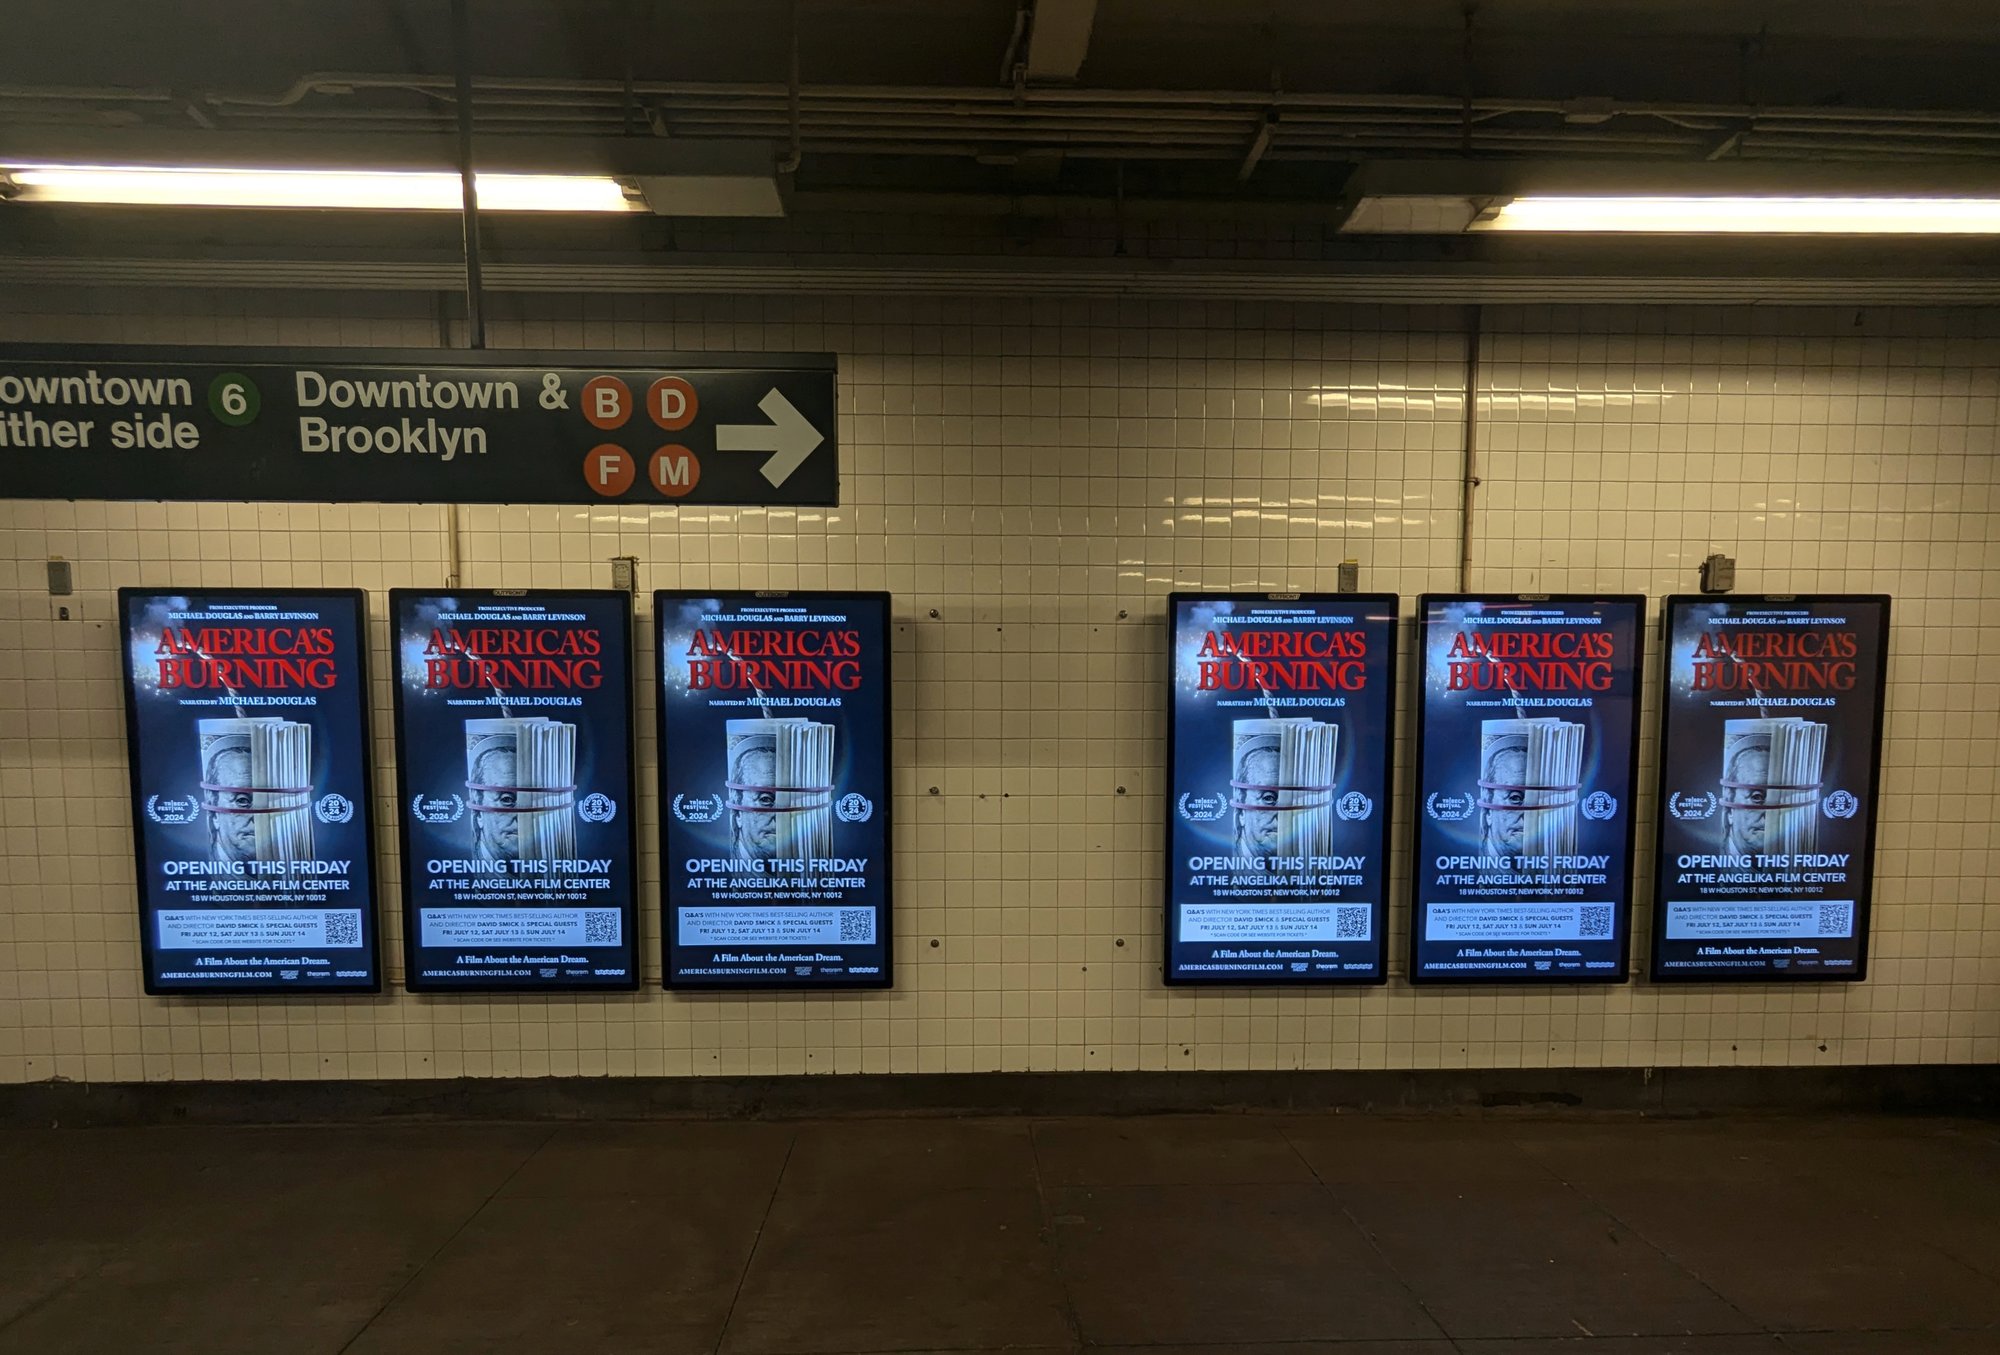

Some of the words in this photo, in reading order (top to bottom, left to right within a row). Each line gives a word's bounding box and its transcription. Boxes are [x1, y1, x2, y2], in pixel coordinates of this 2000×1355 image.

[0, 370, 192, 406] owntown
[296, 371, 519, 409] Downtown
[539, 373, 569, 410] &
[223, 386, 248, 419] 6
[596, 388, 620, 418] B
[661, 389, 686, 418] D
[0, 411, 95, 448] ither
[111, 412, 200, 449] side
[300, 416, 487, 460] Brooklyn
[600, 456, 621, 485] F
[660, 457, 689, 485] M
[152, 626, 334, 655] AMERICA'S
[422, 627, 601, 655] AMERICA'S
[685, 629, 860, 656] AMERICA'S
[1196, 630, 1366, 658] AMERICA'S
[1446, 631, 1614, 658] AMERICA'S
[1691, 630, 1858, 659] AMERICA'S
[155, 657, 337, 689] BURNING
[424, 658, 603, 689] BURNING
[686, 659, 862, 690] BURNING
[1197, 660, 1367, 691] BURNING
[1446, 660, 1614, 691] BURNING
[1690, 660, 1857, 691] BURNING
[218, 696, 266, 705] MICHAEL
[267, 696, 316, 705] DOUGLAS
[485, 697, 532, 705] MICHAEL
[533, 697, 581, 705] DOUGLAS
[746, 697, 792, 705] MICHAEL
[794, 697, 841, 706] DOUGLAS
[1299, 697, 1345, 706] DOUGLAS
[1502, 698, 1546, 706] MICHAEL
[1547, 698, 1592, 706] DOUGLAS
[1790, 697, 1835, 706] DOUGLAS
[163, 860, 244, 875] OPENING
[247, 860, 286, 874] THIS
[290, 860, 351, 874] FRIDAY
[426, 859, 507, 873] OPENING
[510, 859, 547, 873] THIS
[552, 859, 612, 873] FRIDAY
[685, 858, 764, 872] OPENING
[768, 858, 804, 872] THIS
[809, 858, 867, 872] FRIDAY
[1189, 856, 1265, 870] OPENING
[1268, 856, 1304, 869] THIS
[1308, 856, 1365, 869] FRIDAY
[1435, 855, 1511, 869] OPENING
[1514, 855, 1549, 869] THIS
[1553, 855, 1609, 869] FRIDAY
[1677, 854, 1752, 868] OPENING
[1754, 854, 1789, 867] THIS
[1793, 854, 1849, 867] FRIDAY
[428, 879, 444, 889] AT
[445, 879, 469, 889] THE
[471, 878, 532, 889] ANGELIKA
[534, 879, 560, 888] FILM
[564, 878, 610, 888] CENTER
[687, 878, 702, 888] AT
[704, 878, 727, 888] THE
[729, 877, 788, 888] ANGELIKA
[791, 878, 816, 887] FILM
[820, 877, 865, 887] CENTER
[1190, 876, 1204, 885] AT
[1206, 875, 1228, 885] THE
[1230, 875, 1288, 885] ANGELIKA
[1290, 875, 1315, 884] FILM
[1318, 875, 1362, 885] CENTER
[1436, 875, 1451, 884] AT
[1452, 875, 1474, 884] THE
[1476, 874, 1533, 884] ANGELIKA
[1535, 874, 1560, 884] FILM
[1562, 874, 1606, 884] CENTER
[1677, 874, 1692, 883] AT
[1693, 873, 1715, 883] THE
[1717, 873, 1773, 883] ANGELIKA
[1775, 873, 1800, 882] FILM
[1802, 872, 1846, 882] CENTER
[165, 881, 181, 890] AT
[182, 880, 207, 890] THE
[208, 880, 270, 890] ANGELIKA
[272, 880, 299, 890] FILM
[302, 880, 349, 890] CENTER
[456, 955, 463, 963] A
[465, 955, 482, 963] Film
[484, 955, 508, 963] About
[509, 955, 521, 963] the
[523, 955, 559, 963] American
[560, 955, 589, 963] Dream.
[1465, 948, 1481, 956] Film
[1483, 948, 1505, 956] About
[1507, 948, 1518, 956] the
[1519, 948, 1553, 956] American
[1554, 948, 1581, 956] Dream.
[195, 957, 203, 965] A
[204, 957, 222, 965] Film
[223, 957, 248, 965] About
[249, 957, 262, 965] the
[263, 957, 299, 965] American
[301, 956, 330, 964] Dream.
